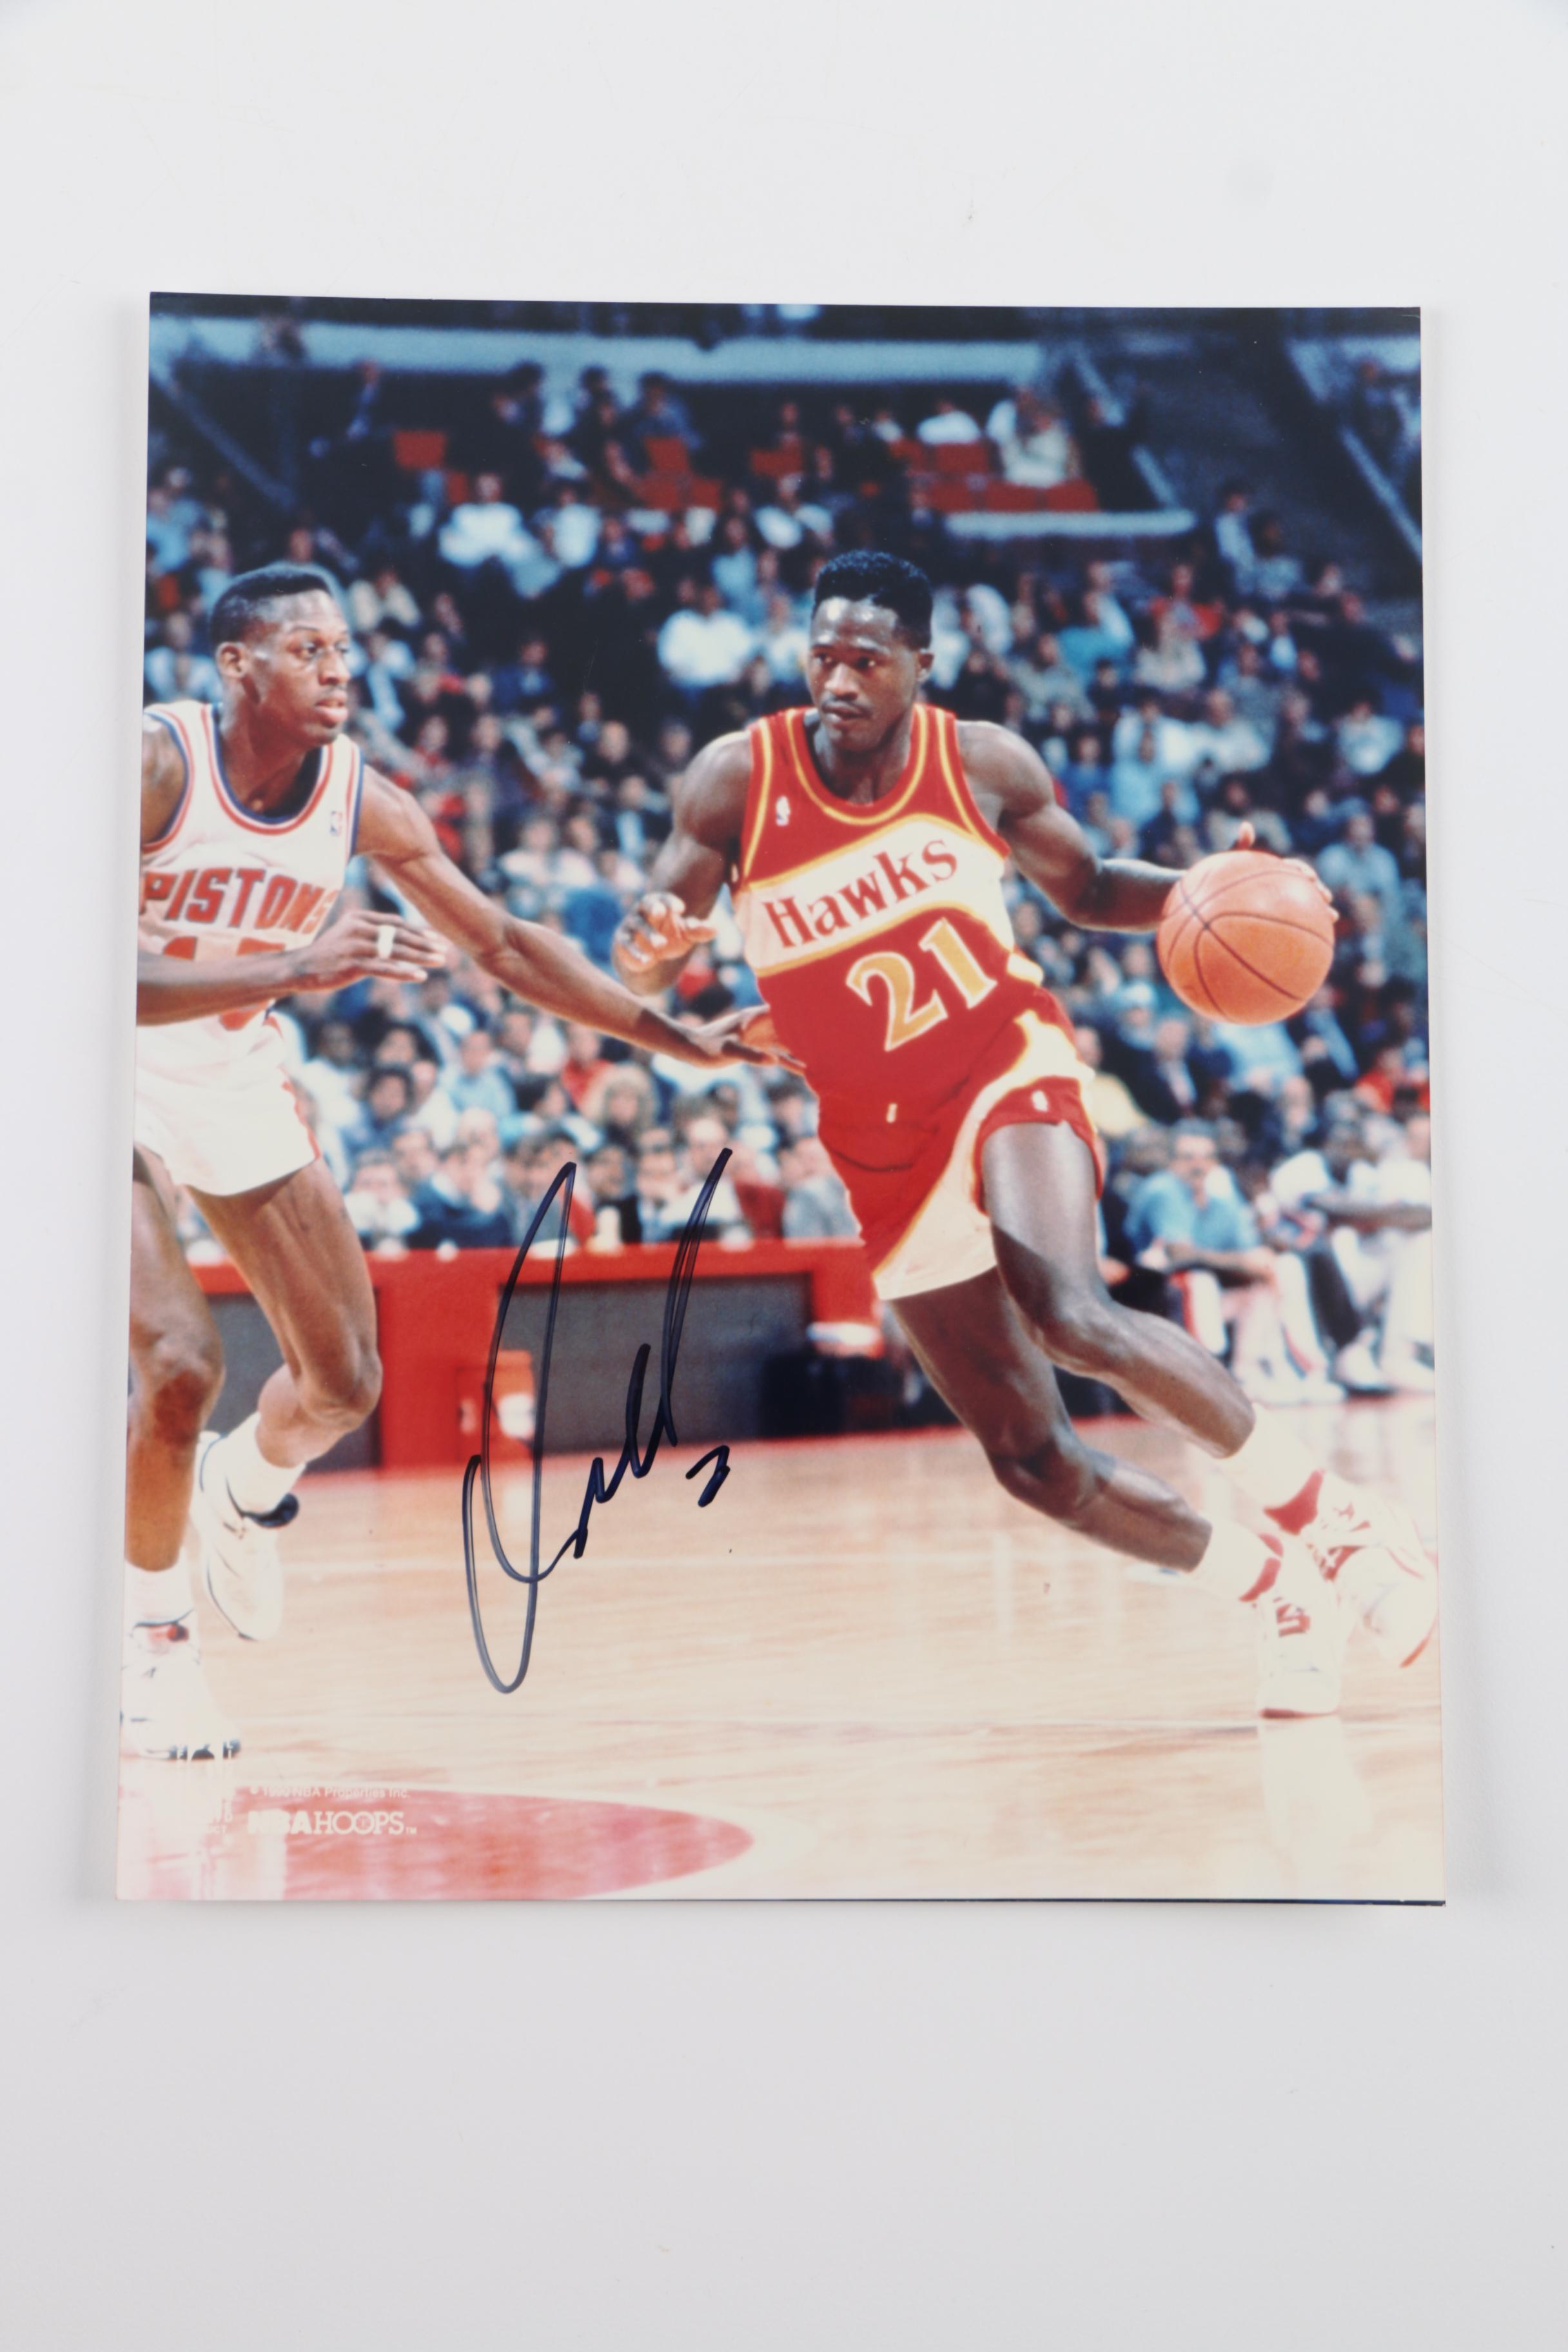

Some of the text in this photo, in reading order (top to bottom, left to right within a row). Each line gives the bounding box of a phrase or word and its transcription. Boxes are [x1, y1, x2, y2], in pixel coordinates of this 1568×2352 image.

[139, 867, 340, 934] PISTONS
[762, 839, 958, 948] Hawks
[845, 916, 997, 1052] 21
[293, 1787, 321, 1798] NBA
[324, 1787, 386, 1799] Properties
